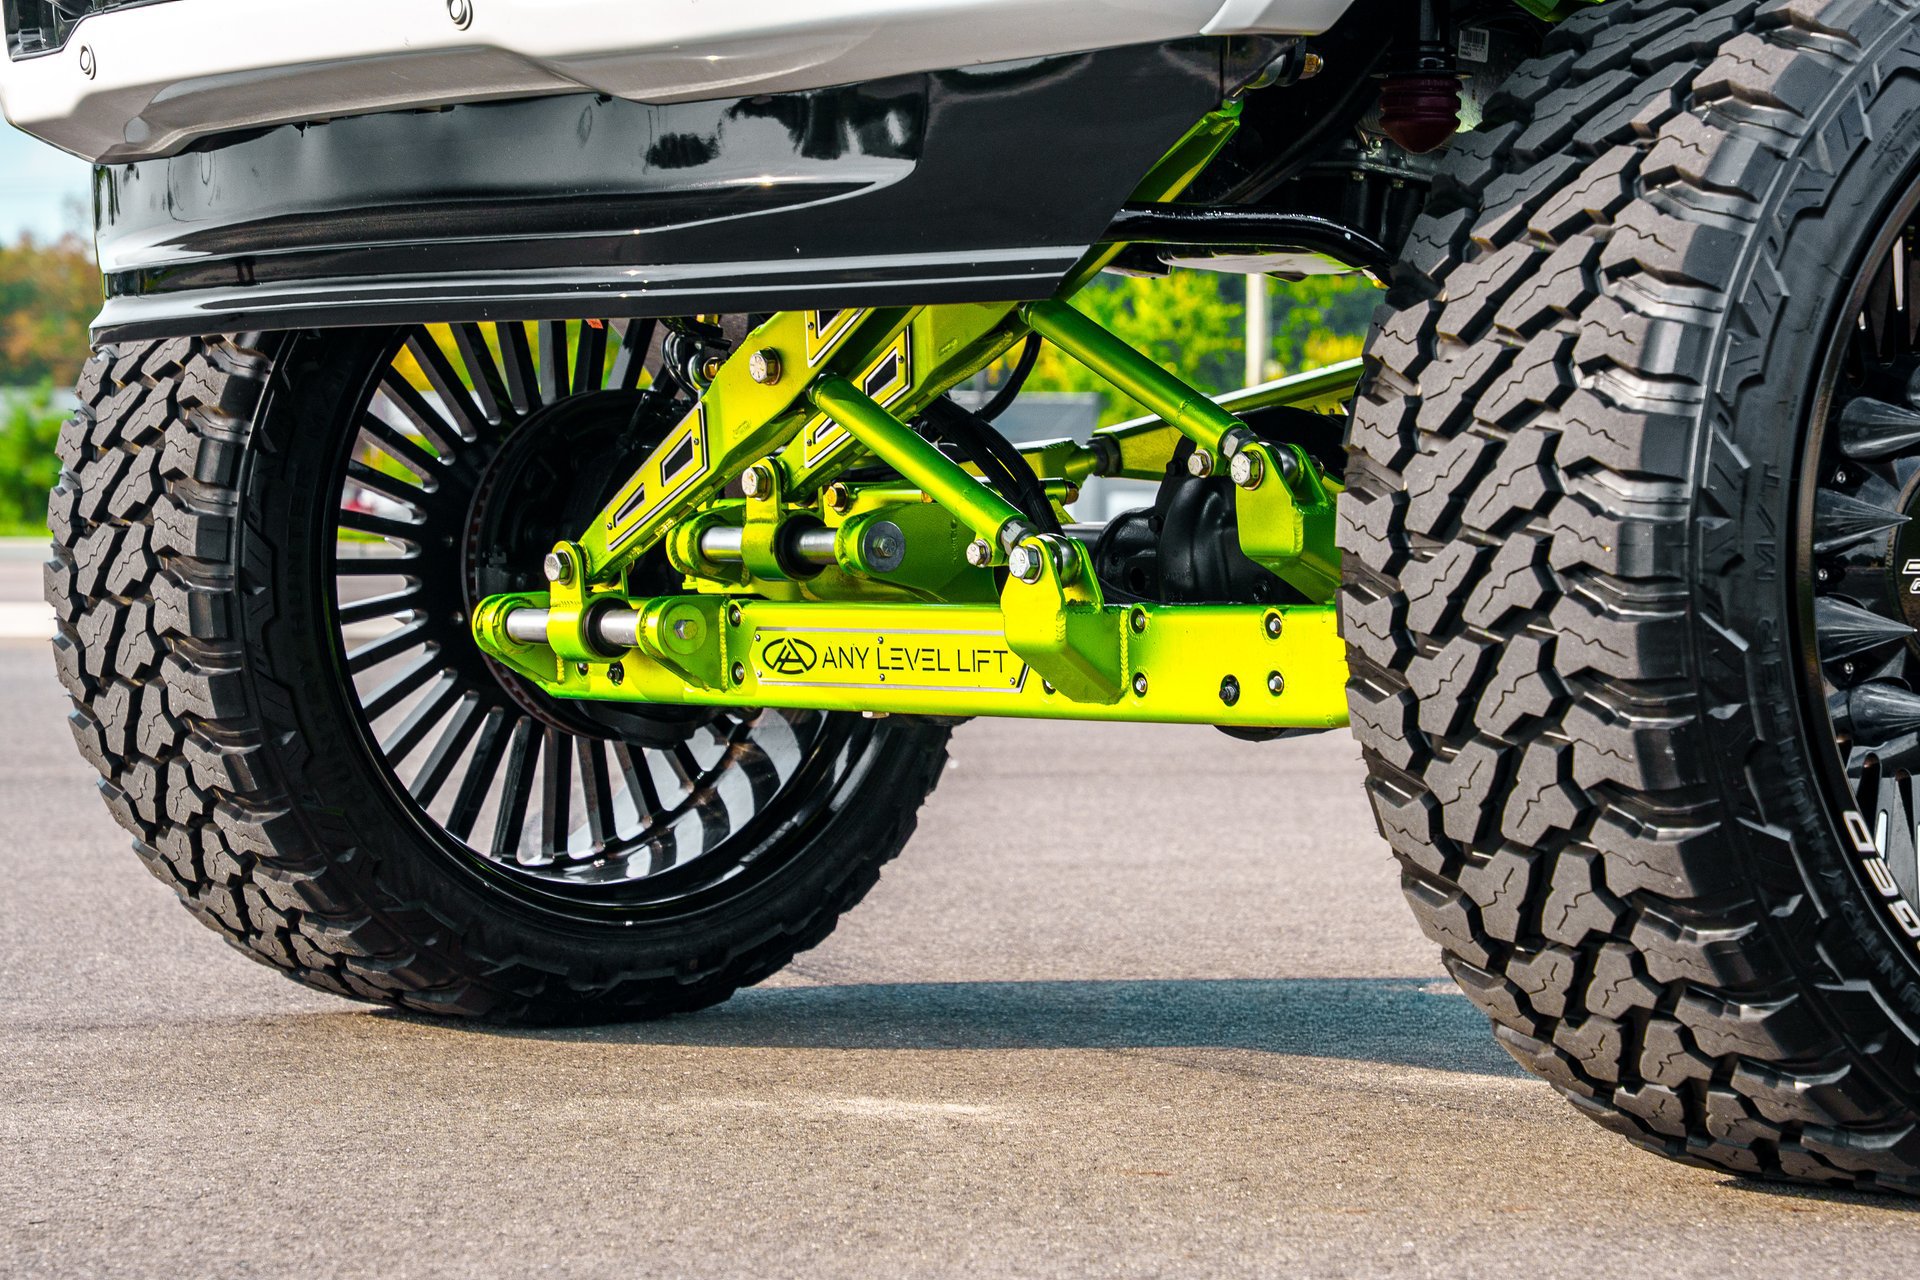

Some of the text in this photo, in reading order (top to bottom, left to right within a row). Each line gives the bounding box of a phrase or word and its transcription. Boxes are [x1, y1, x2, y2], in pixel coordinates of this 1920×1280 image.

[821, 646, 1009, 674] ANY LEVEL LIFT
